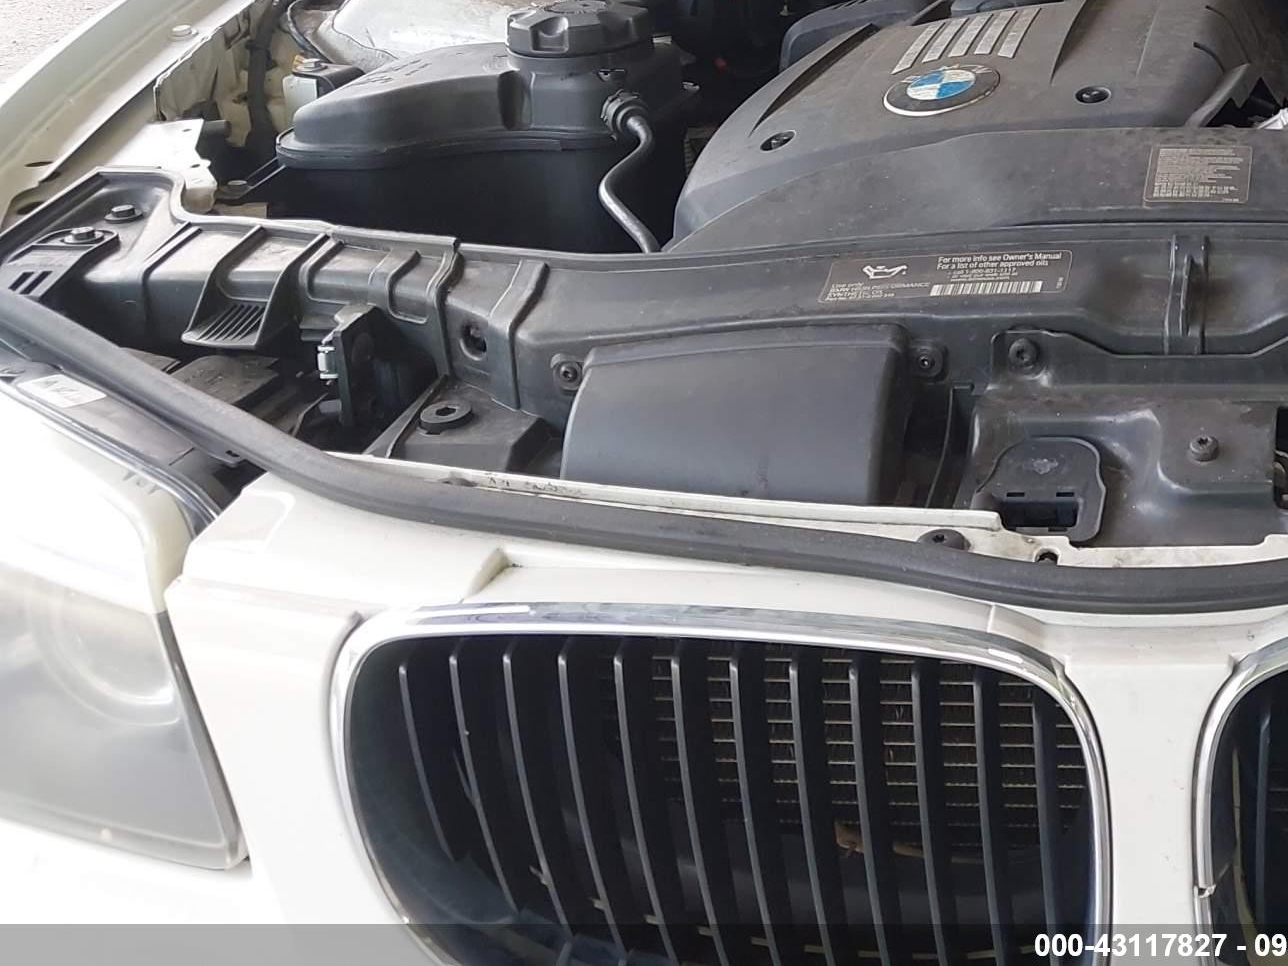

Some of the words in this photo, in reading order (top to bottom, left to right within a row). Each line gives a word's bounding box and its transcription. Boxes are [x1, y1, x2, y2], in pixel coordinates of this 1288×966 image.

[938, 256, 951, 264] For
[952, 255, 972, 263] more
[973, 254, 987, 262] info
[1002, 253, 1033, 262] Owner's
[1034, 252, 1062, 260] Manual
[1000, 260, 1035, 269] approved
